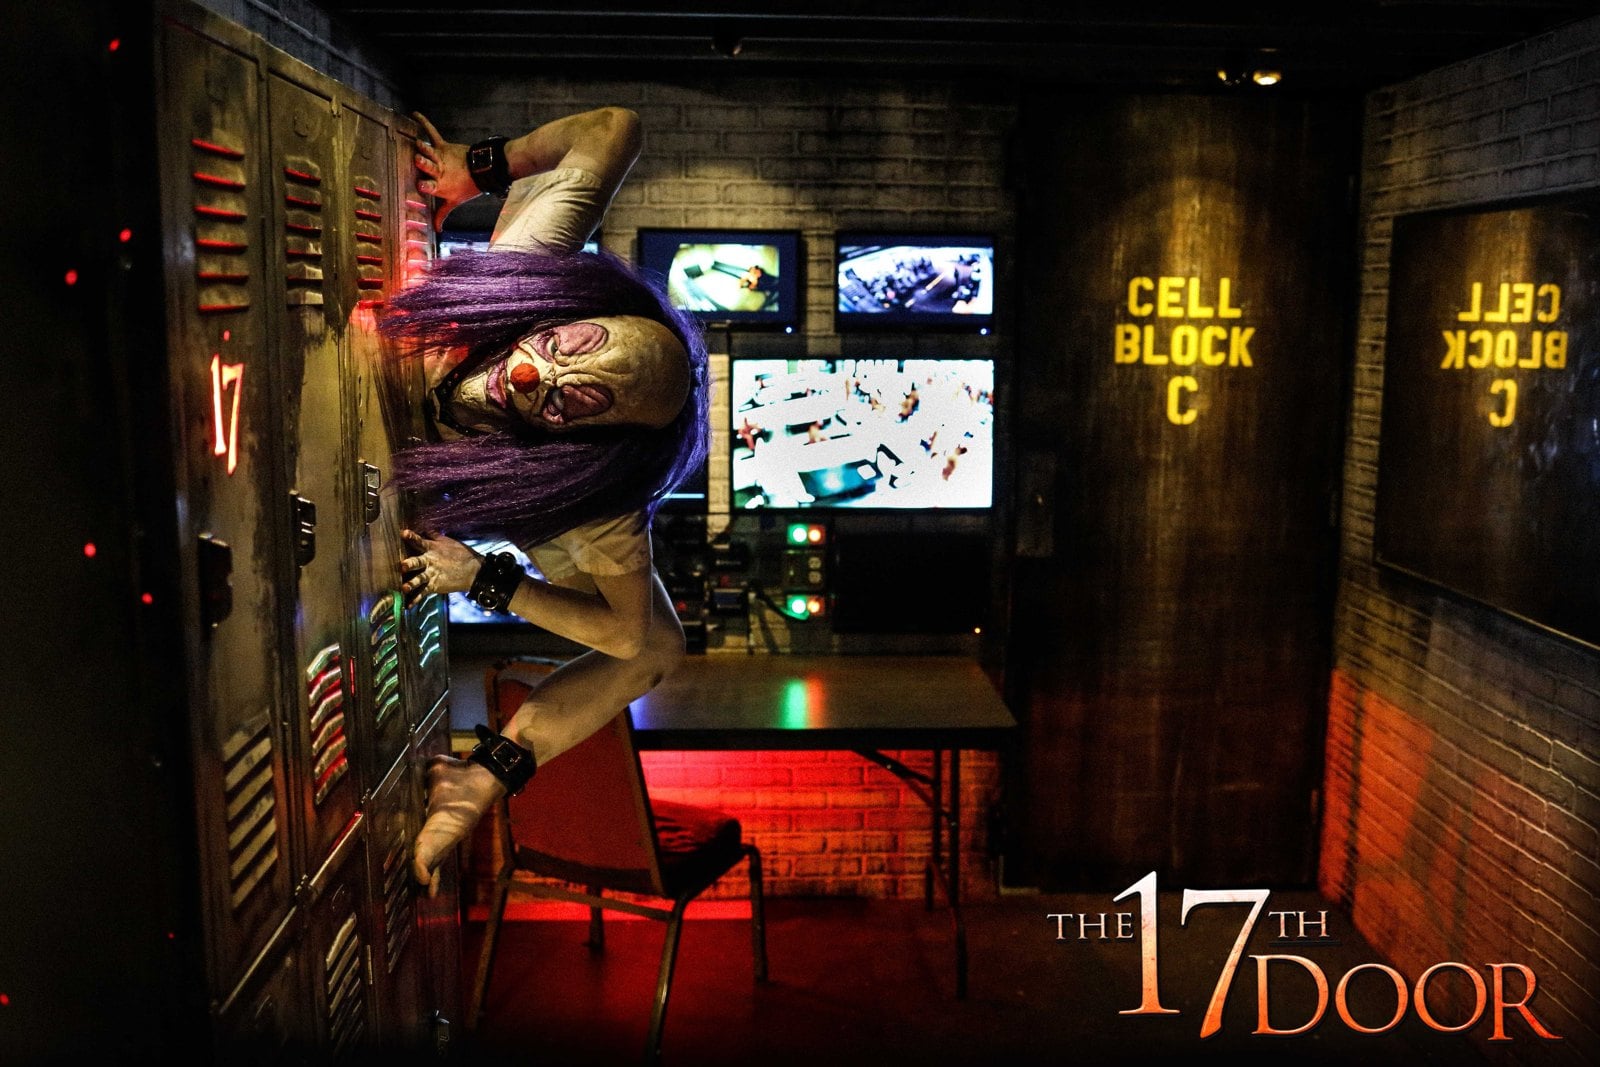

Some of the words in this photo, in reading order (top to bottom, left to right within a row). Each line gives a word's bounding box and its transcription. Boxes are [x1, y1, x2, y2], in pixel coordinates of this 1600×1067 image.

[1127, 276, 1243, 319] CELL
[1113, 323, 1257, 368] BLOCK
[210, 353, 244, 476] 17
[1166, 374, 1199, 426] C
